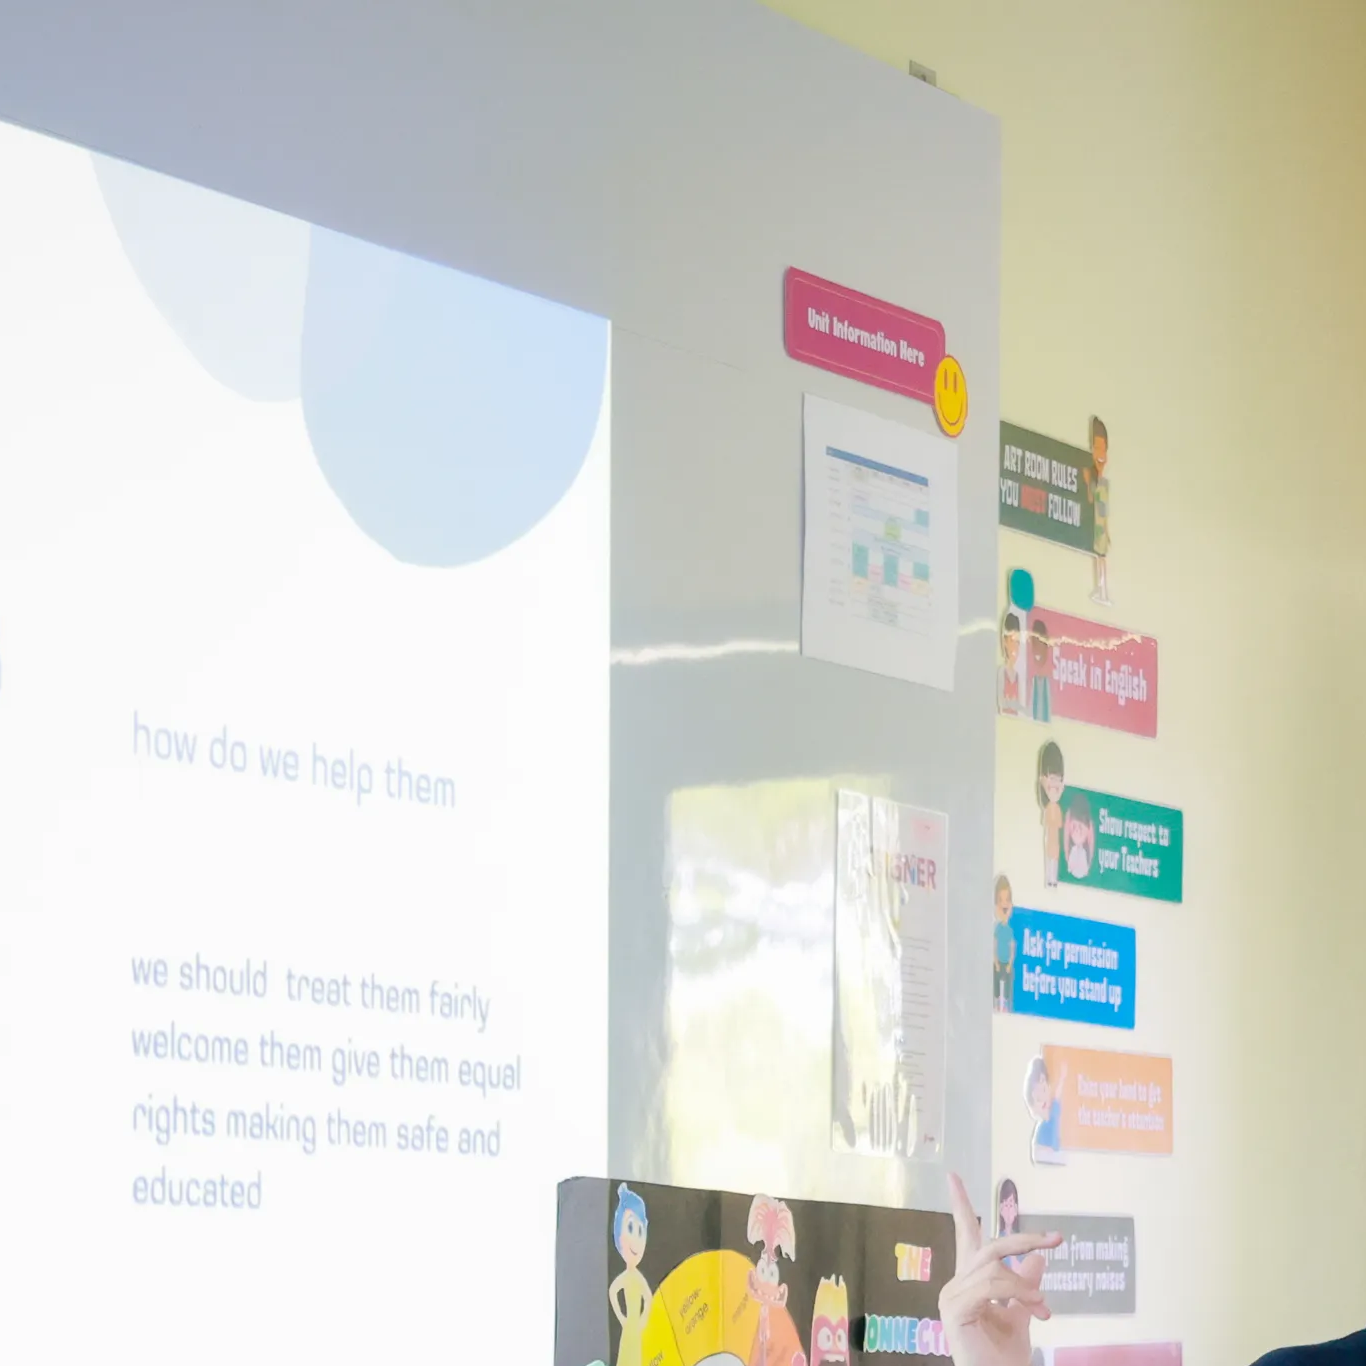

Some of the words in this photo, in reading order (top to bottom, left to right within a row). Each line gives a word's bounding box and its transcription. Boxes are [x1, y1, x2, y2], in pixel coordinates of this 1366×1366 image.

[808, 307, 830, 334] Unit
[833, 316, 897, 358] Information
[899, 338, 925, 367] Here
[1004, 444, 1023, 473] ART
[1024, 450, 1050, 483] ROOM
[1051, 459, 1078, 493] RULES
[1000, 477, 1019, 507] YOU
[1048, 493, 1081, 527] FOLLOW
[1053, 645, 1087, 691] Speak
[1090, 654, 1102, 691] in
[1105, 659, 1147, 706] English
[132, 709, 196, 764] how
[209, 724, 247, 772] do
[259, 745, 300, 781] we
[311, 742, 373, 807] help
[384, 757, 455, 808] them
[1099, 807, 1123, 837] Show
[1124, 820, 1156, 848] respect
[1158, 825, 1169, 847] to
[1098, 848, 1120, 874] your
[1121, 846, 1159, 878] Teachers
[1022, 927, 1043, 958] Ask
[1045, 931, 1062, 967] for
[1064, 939, 1119, 970] permission
[132, 956, 168, 987] we
[179, 952, 267, 998] should
[286, 968, 351, 1007] treat
[360, 973, 420, 1014] them
[429, 980, 490, 1033] fairly
[1022, 963, 1057, 1001] before
[1058, 976, 1078, 1004] you
[1079, 976, 1107, 1004] stand
[1108, 984, 1122, 1013] up
[132, 1021, 249, 1065] welcome
[259, 1031, 321, 1071] them
[331, 1038, 381, 1086] give
[390, 1044, 448, 1083] them
[458, 1055, 521, 1098] equal
[133, 1093, 215, 1146] rights
[226, 1102, 315, 1155] making
[327, 1108, 386, 1148] them
[396, 1114, 449, 1152] safe
[458, 1120, 501, 1157] and
[132, 1165, 261, 1210] educated
[1070, 1234, 1094, 1267] from
[1096, 1234, 1129, 1268] making
[1096, 1265, 1126, 1292] noises
